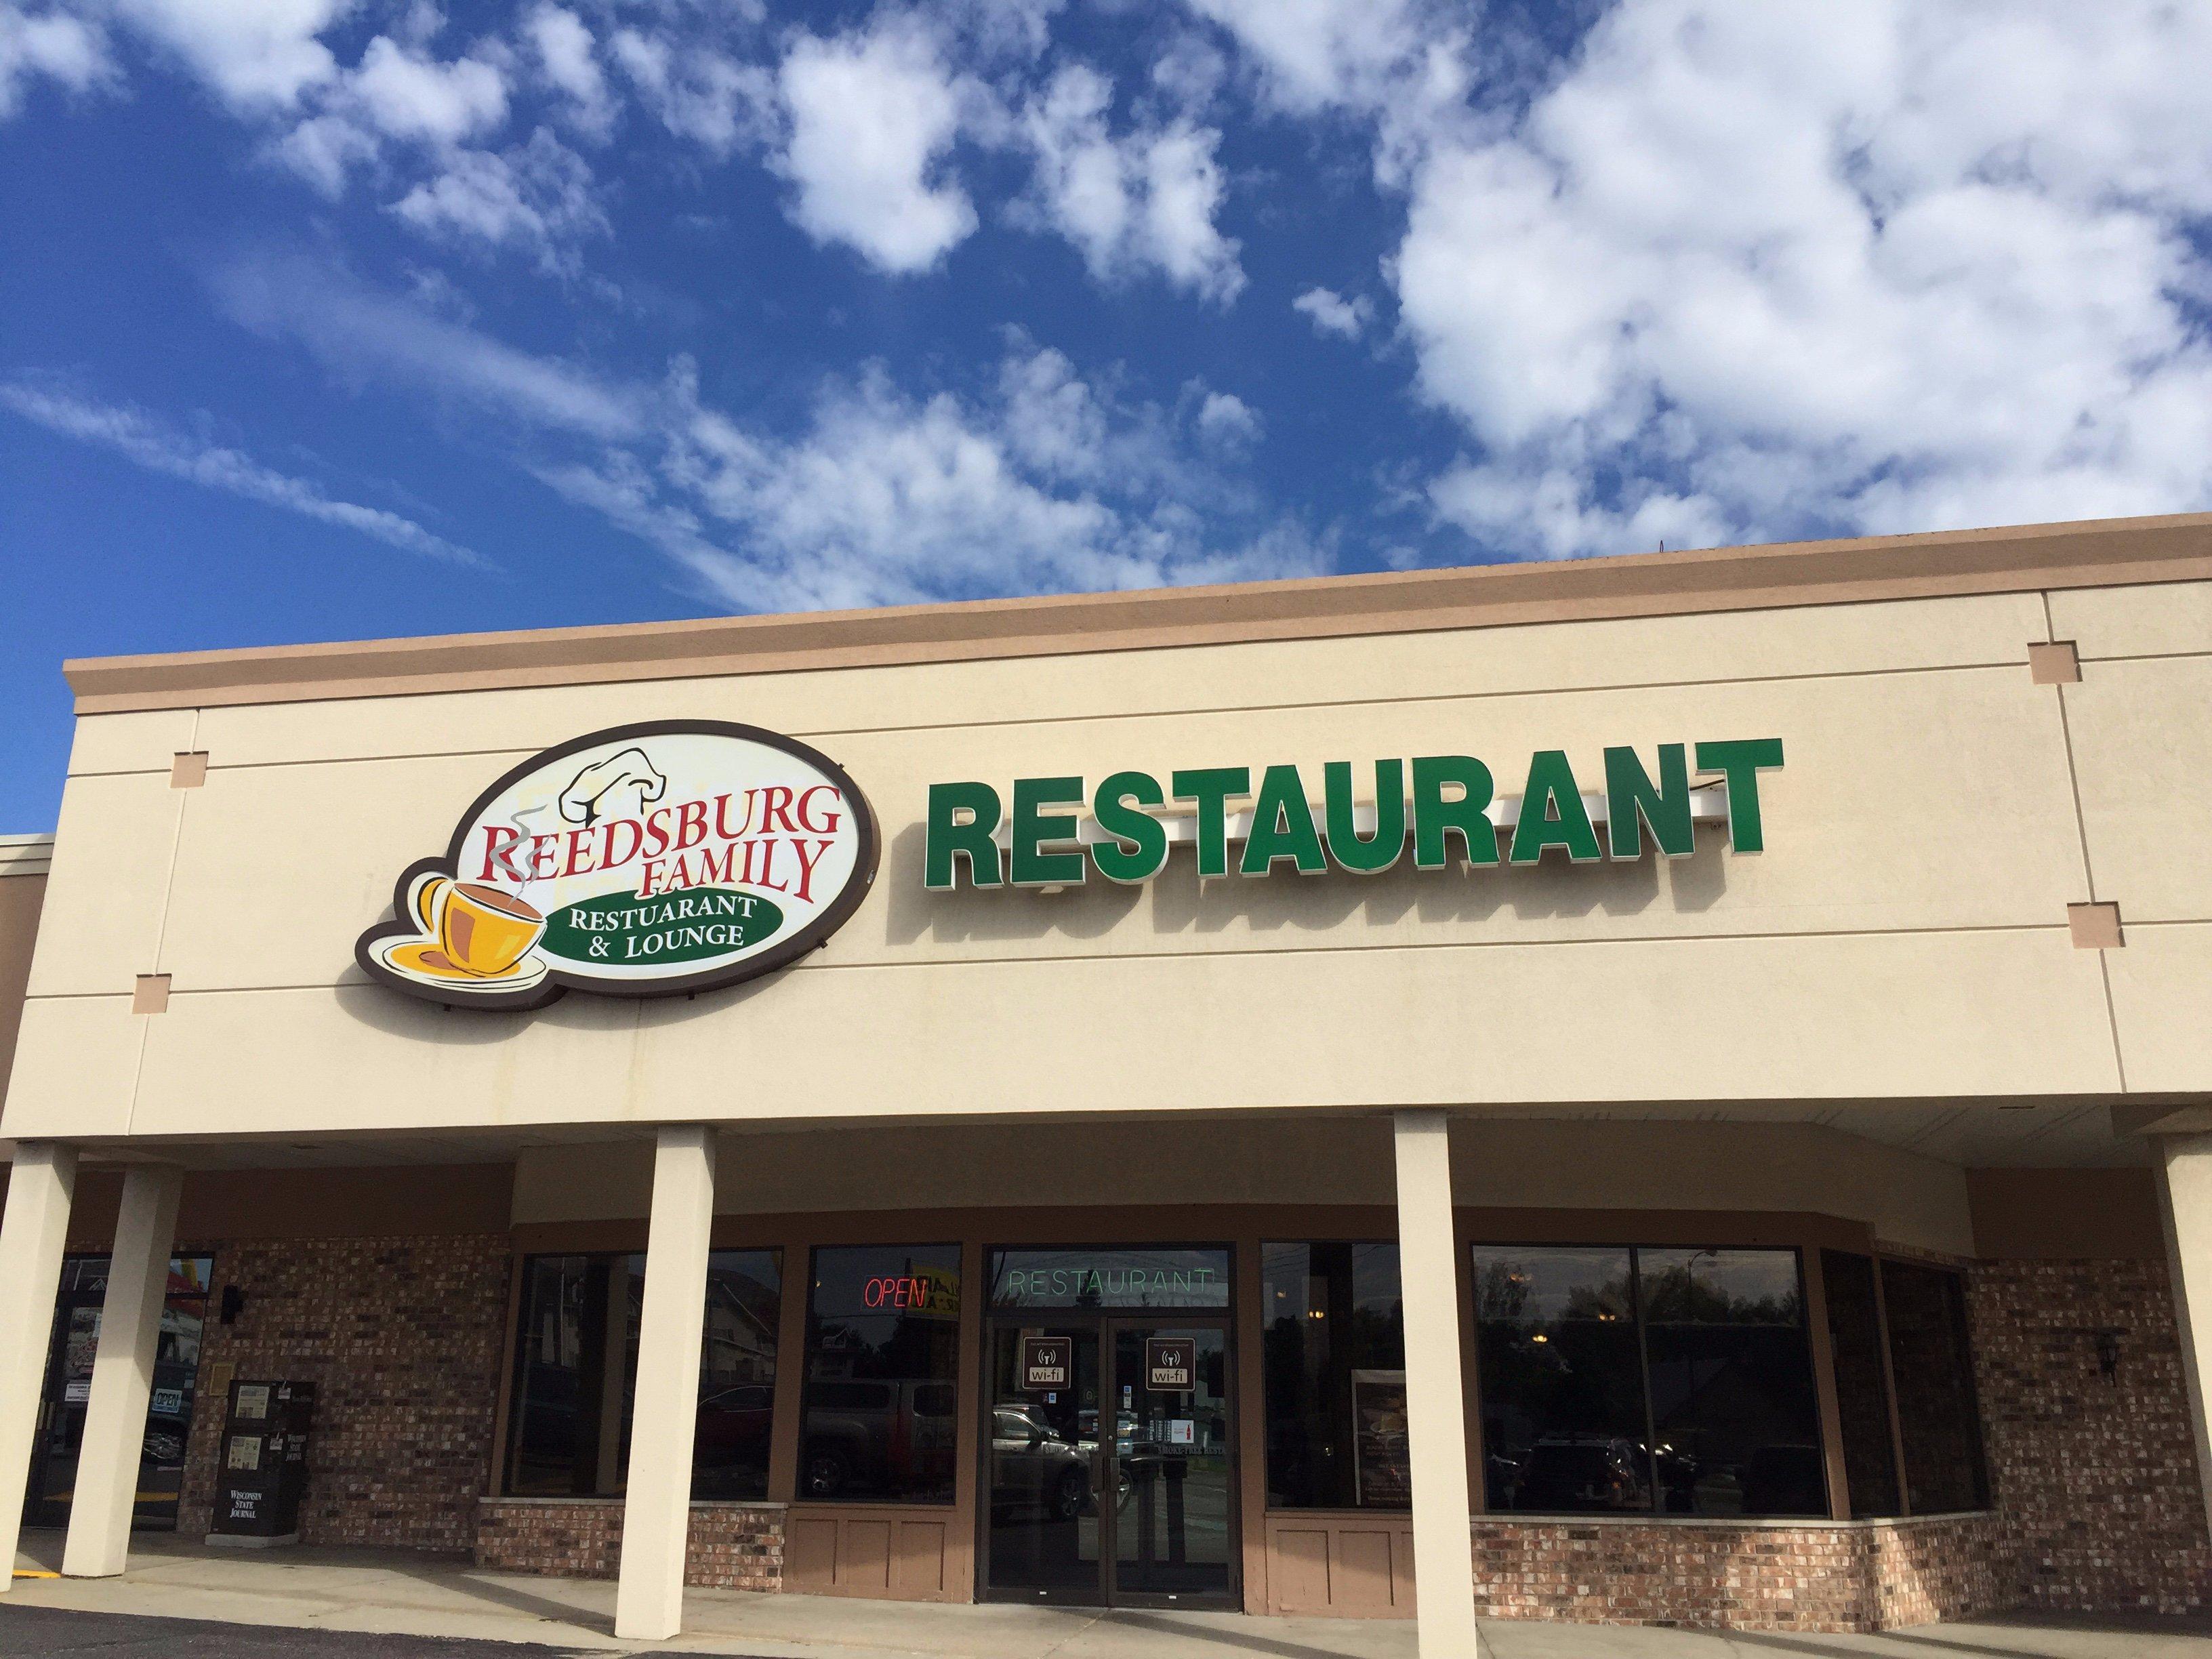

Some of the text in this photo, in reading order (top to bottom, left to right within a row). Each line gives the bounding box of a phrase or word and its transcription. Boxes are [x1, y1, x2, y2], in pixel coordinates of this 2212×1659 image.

[925, 738, 1784, 890] RESTAURANT
[476, 786, 842, 882] REEDSBURG
[638, 839, 834, 904] FAMILY
[569, 895, 758, 931] RESTUARANT
[589, 925, 745, 958] & LOUNGE
[865, 1278, 926, 1307] OPEN
[1008, 1268, 1212, 1295] RESTAURANT
[1031, 1368, 1060, 1381] wi-fi
[1155, 1370, 1183, 1382] wi-fi
[157, 1393, 180, 1406] OPEN
[230, 1490, 262, 1500] WISCONSIN
[234, 1500, 254, 1509] STATE
[230, 1509, 256, 1519] JOURNAL
